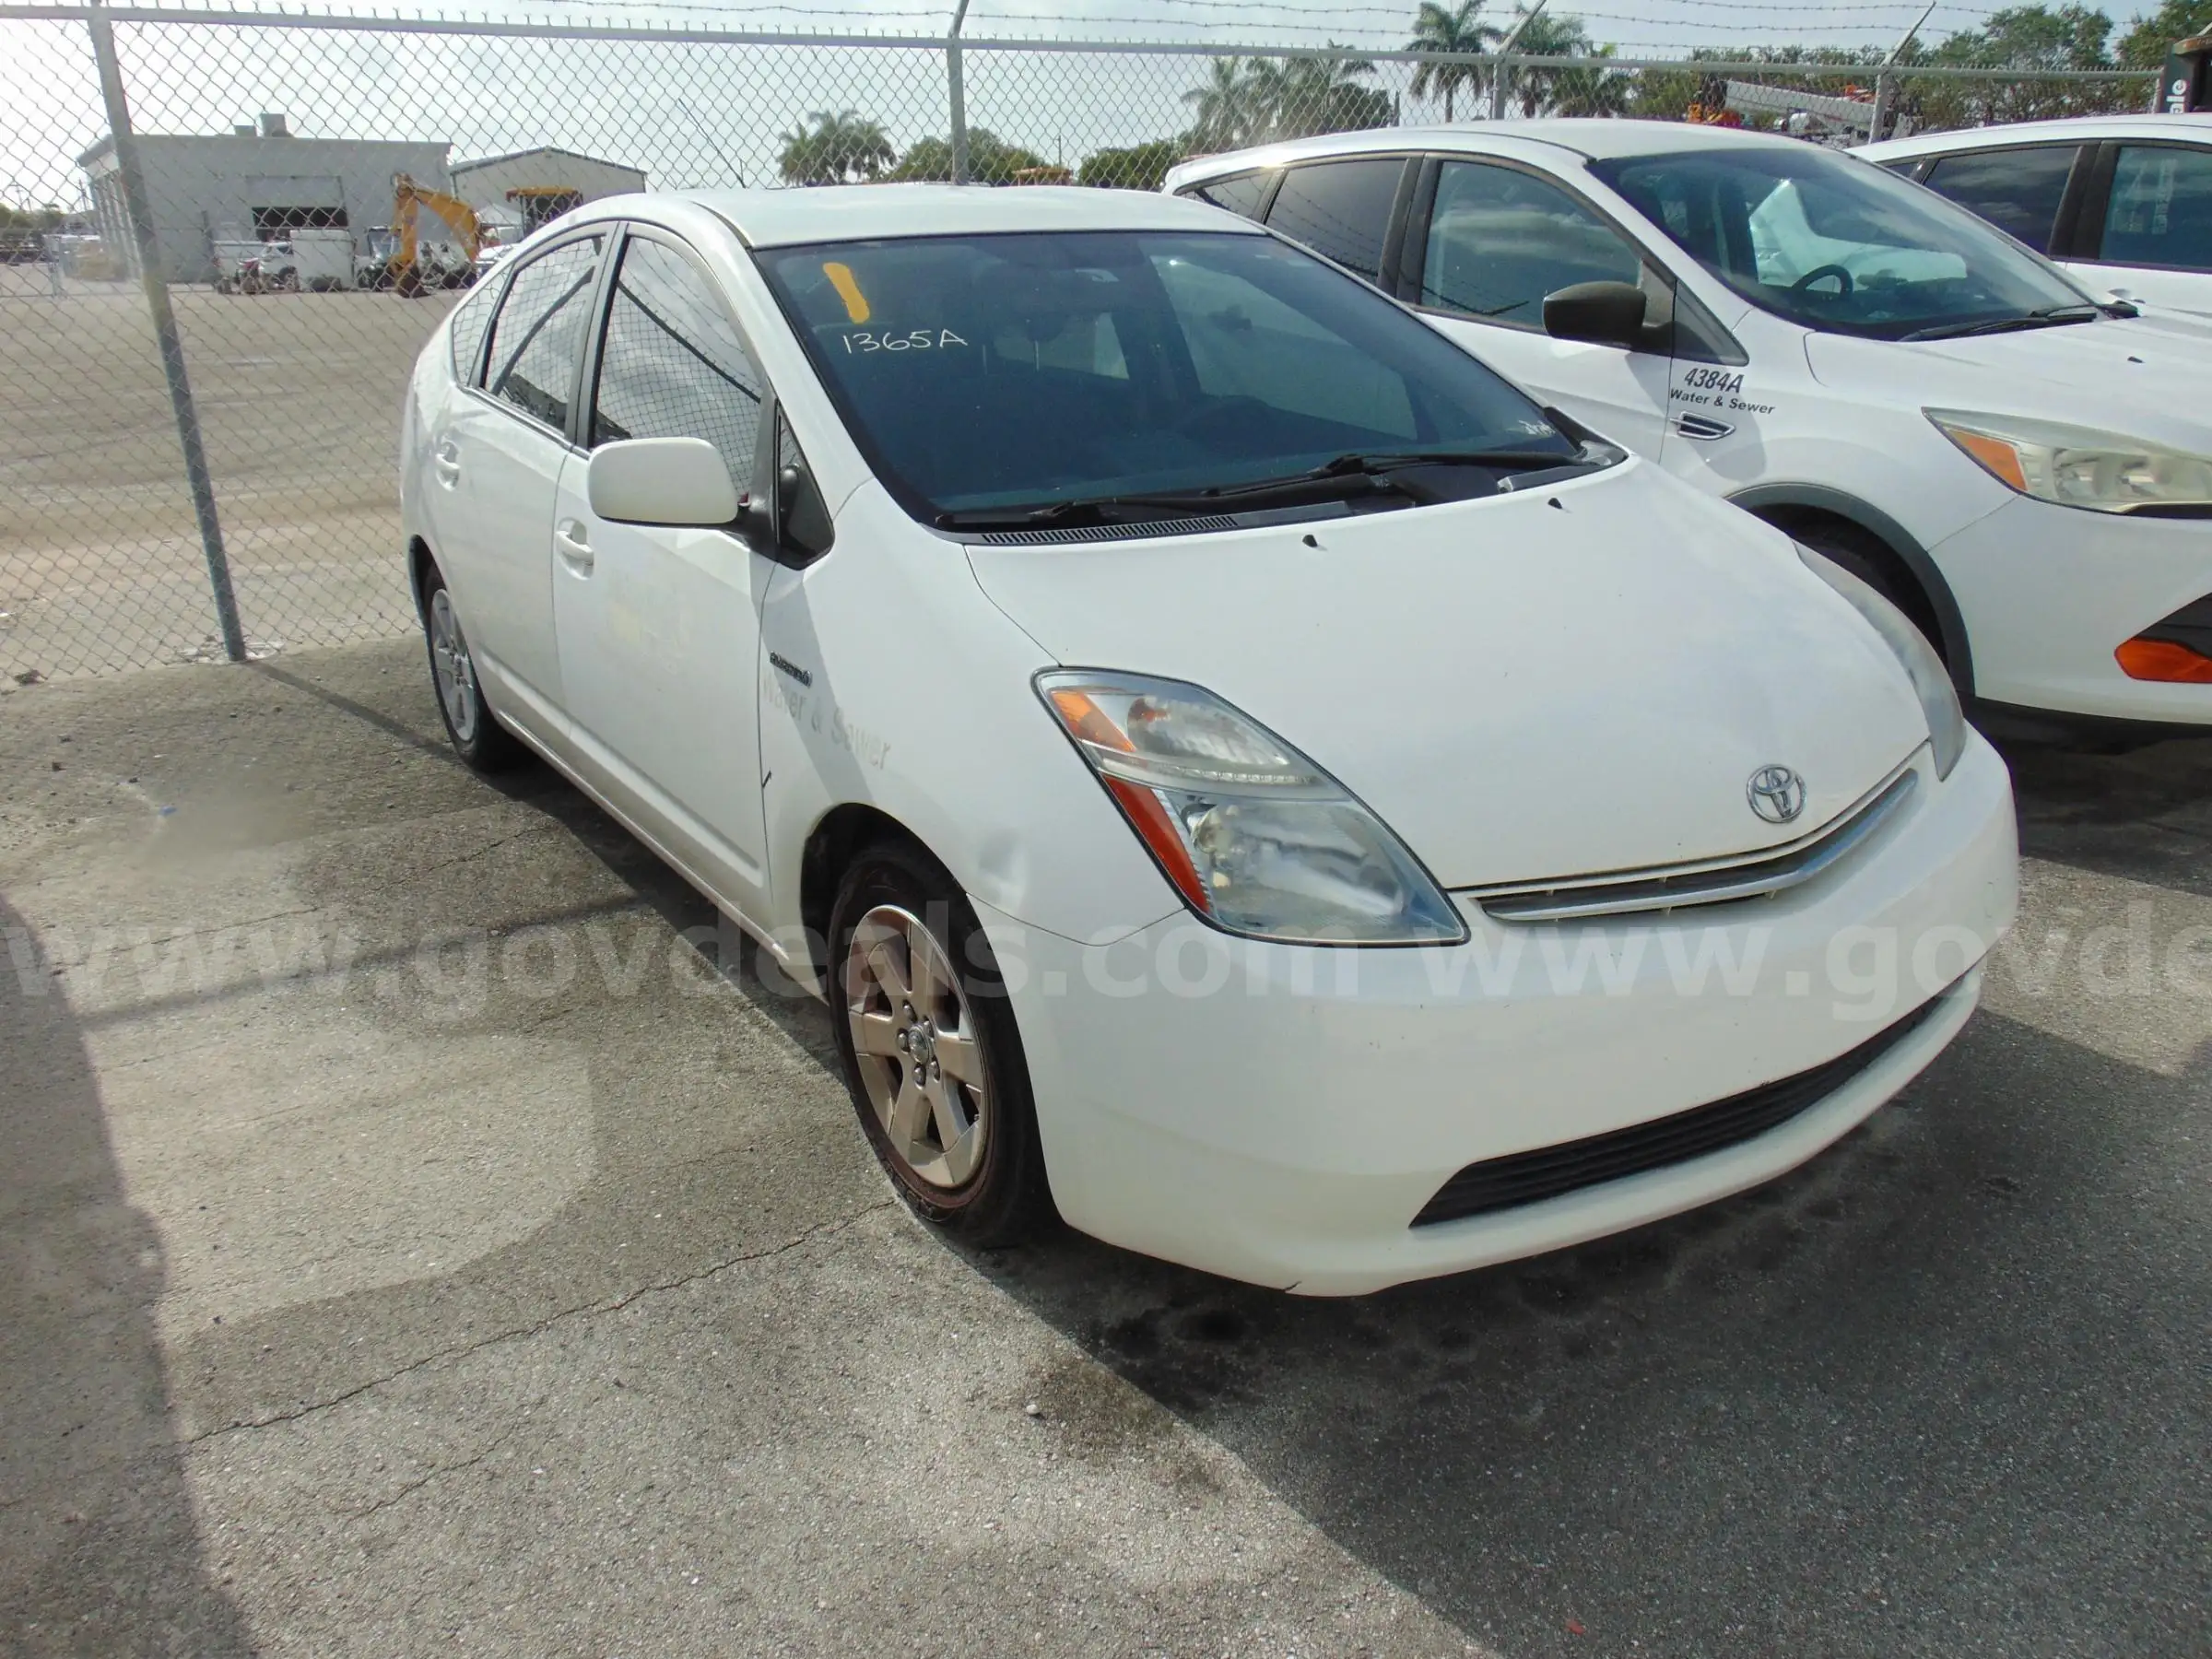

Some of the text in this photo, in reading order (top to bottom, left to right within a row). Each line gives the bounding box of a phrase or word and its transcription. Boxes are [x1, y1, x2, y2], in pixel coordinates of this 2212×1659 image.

[842, 328, 968, 354] 1365A
[1684, 368, 1745, 394] 4384A
[1669, 387, 1777, 415] Water & Sewer
